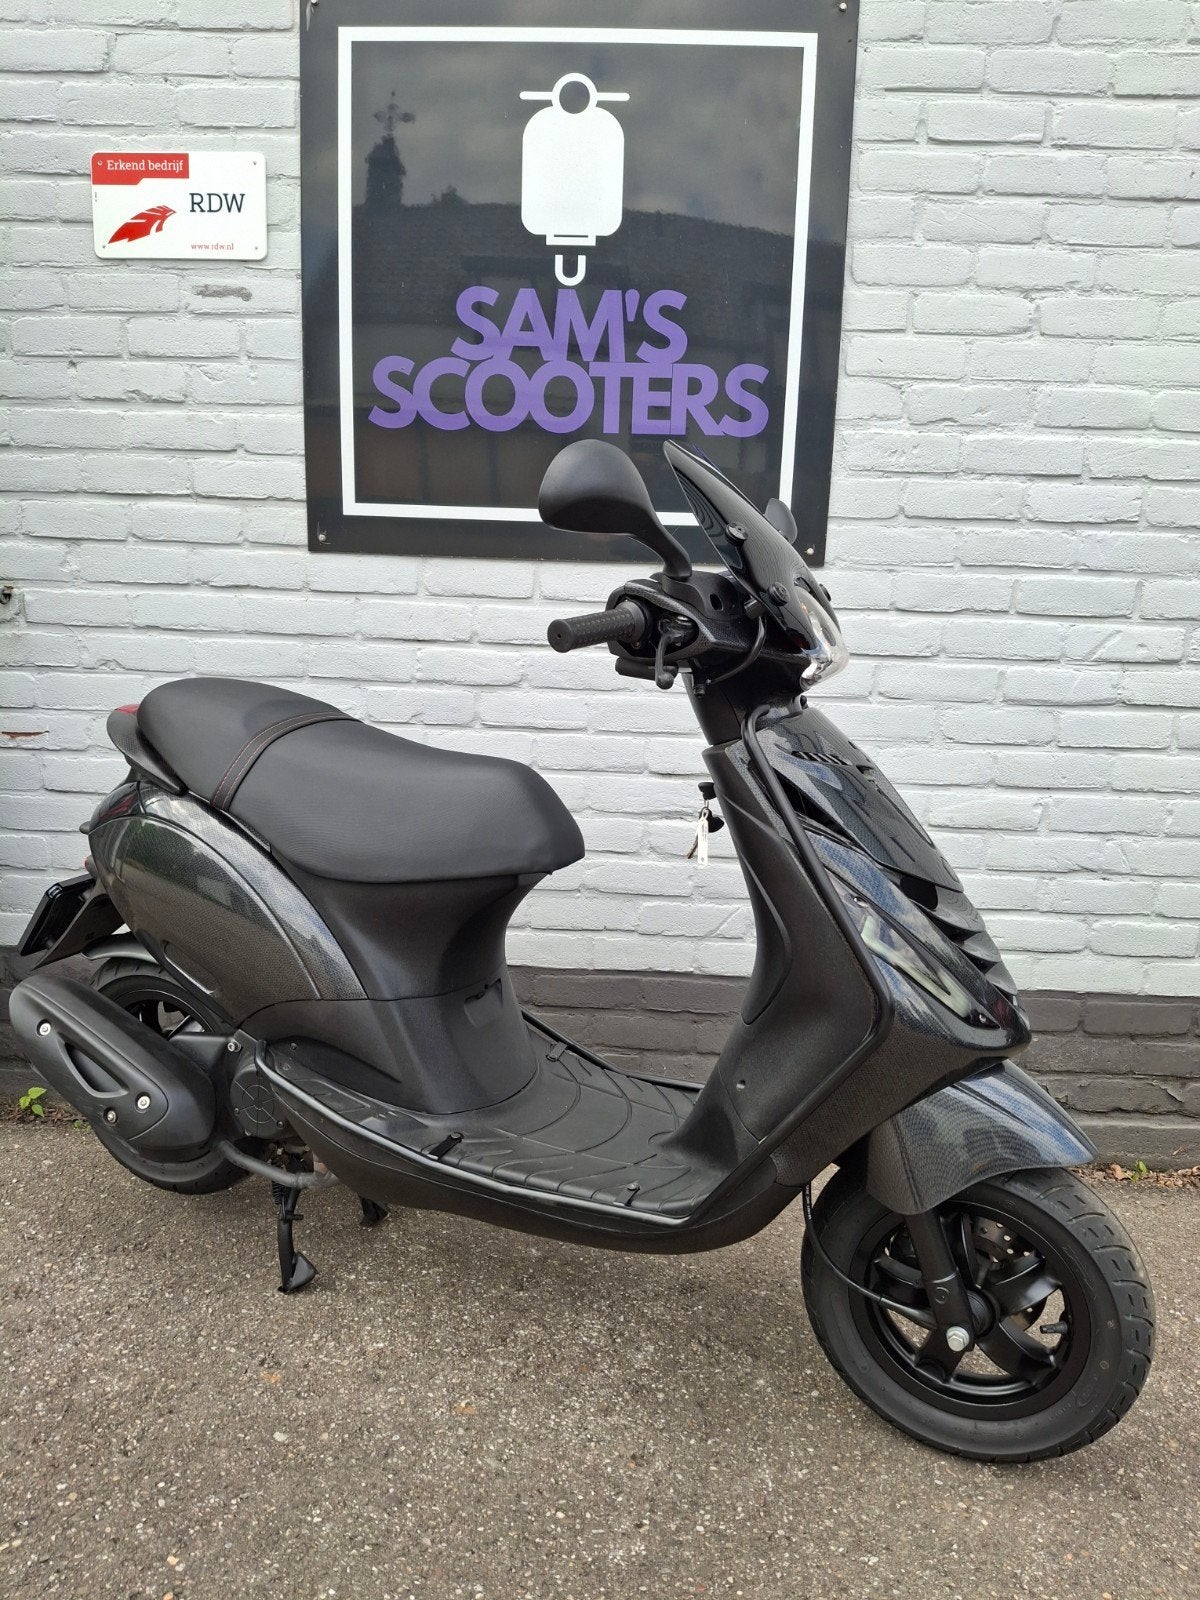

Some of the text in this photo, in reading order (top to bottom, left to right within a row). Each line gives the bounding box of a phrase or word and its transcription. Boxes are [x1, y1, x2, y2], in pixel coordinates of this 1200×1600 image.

[107, 159, 184, 173] Erkend bedrijf
[189, 192, 246, 213] RDW
[190, 242, 235, 251] www.rdw.nl
[450, 285, 689, 363] SAM'S
[367, 355, 770, 438] SCOOTERS
